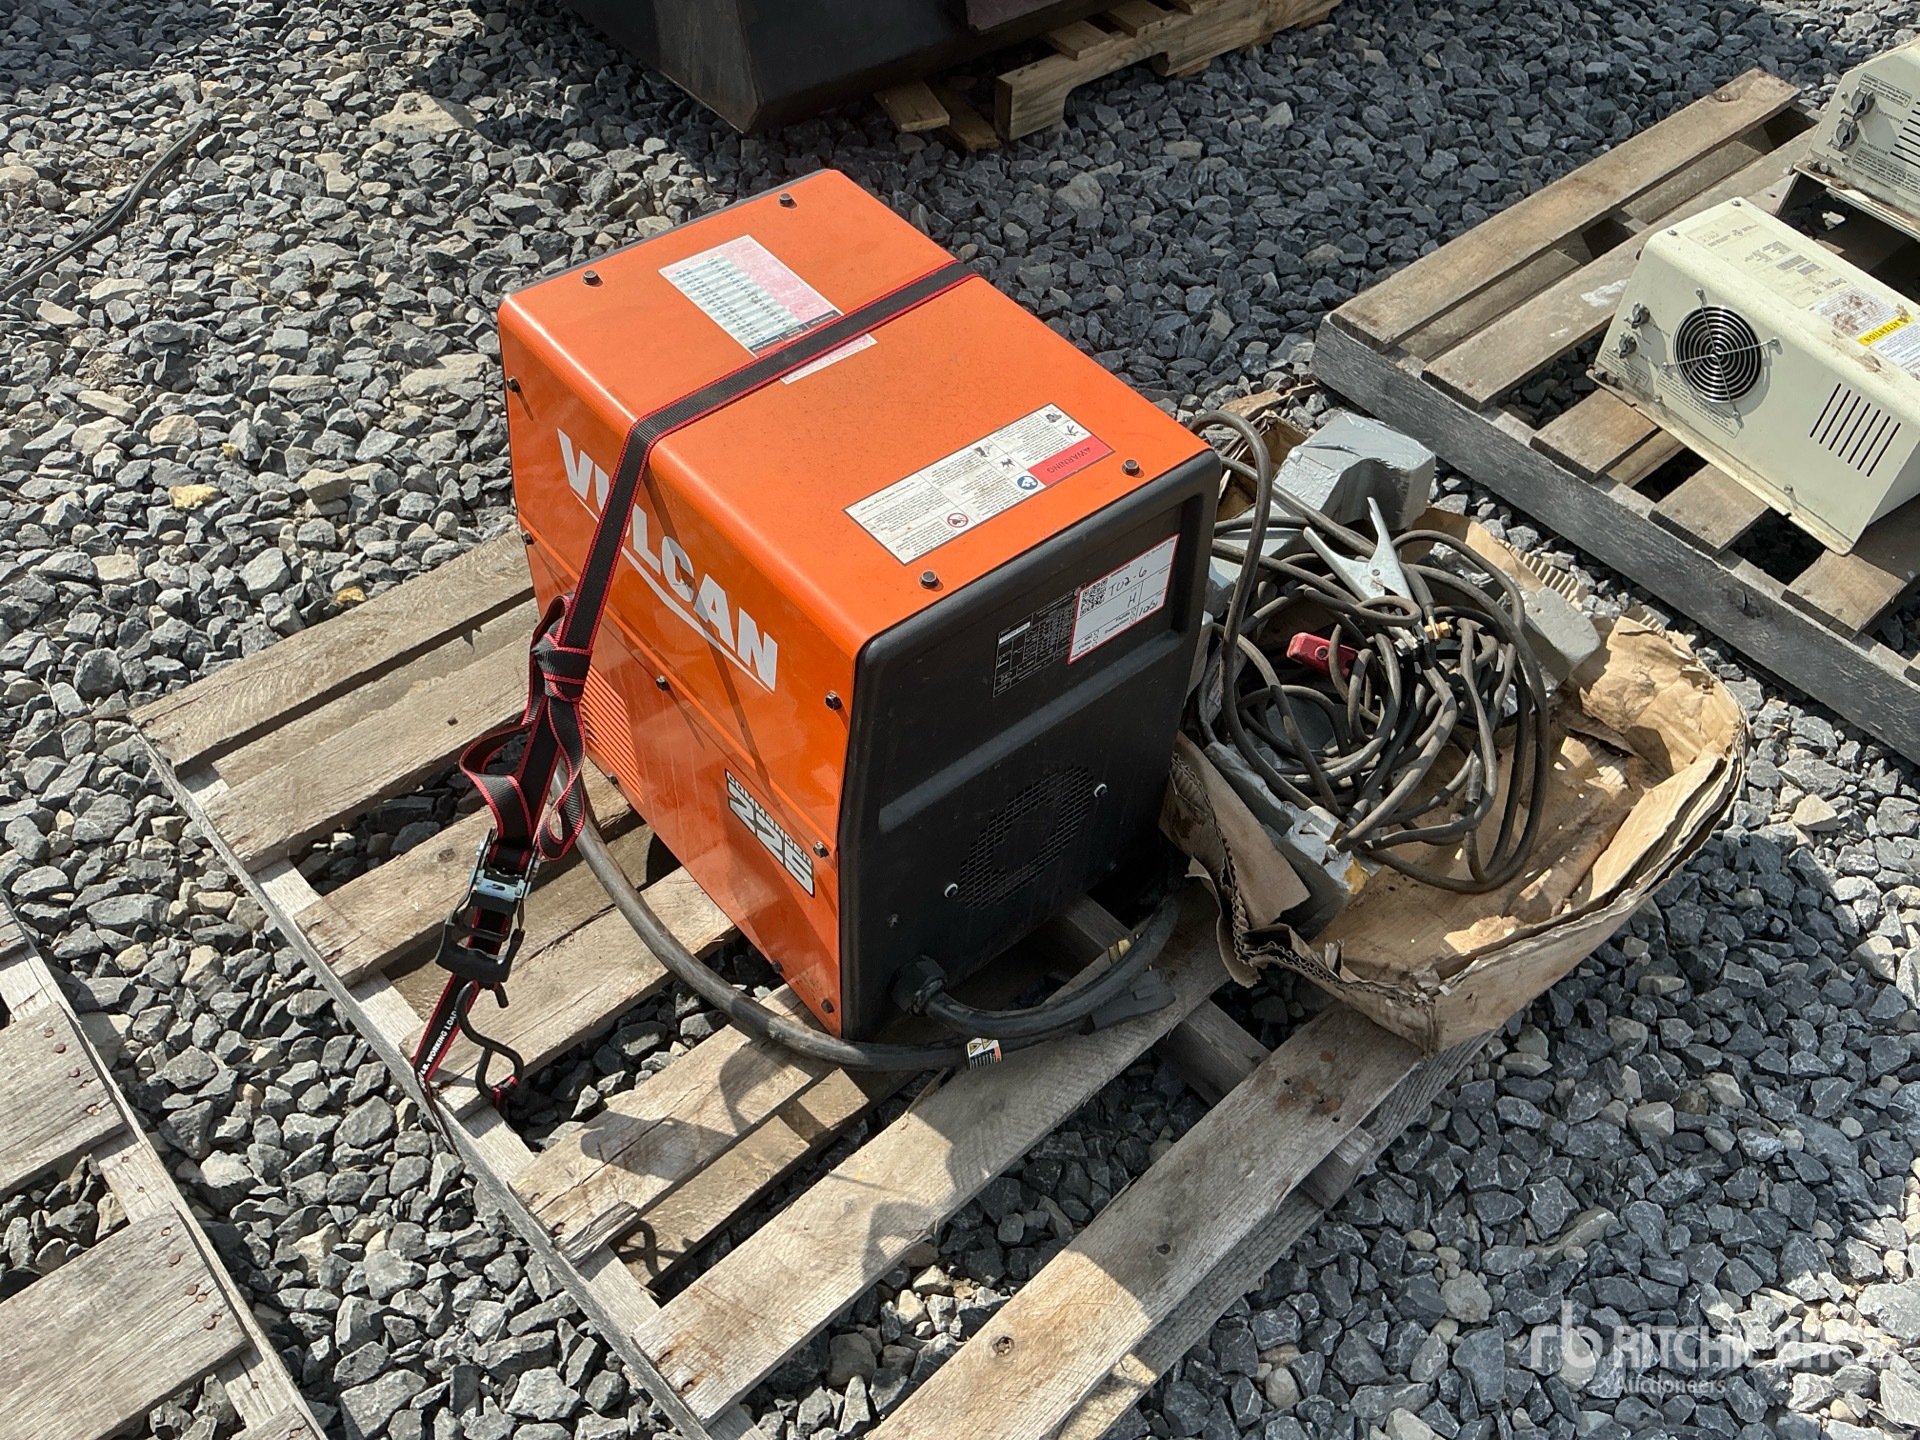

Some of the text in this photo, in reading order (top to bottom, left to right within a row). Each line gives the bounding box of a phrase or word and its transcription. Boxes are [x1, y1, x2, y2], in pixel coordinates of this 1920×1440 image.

[1863, 320, 1900, 343] ATTENTION
[1046, 449, 1087, 474] WARNING
[728, 782, 814, 895] 225
[426, 1030, 448, 1063] WORKING
